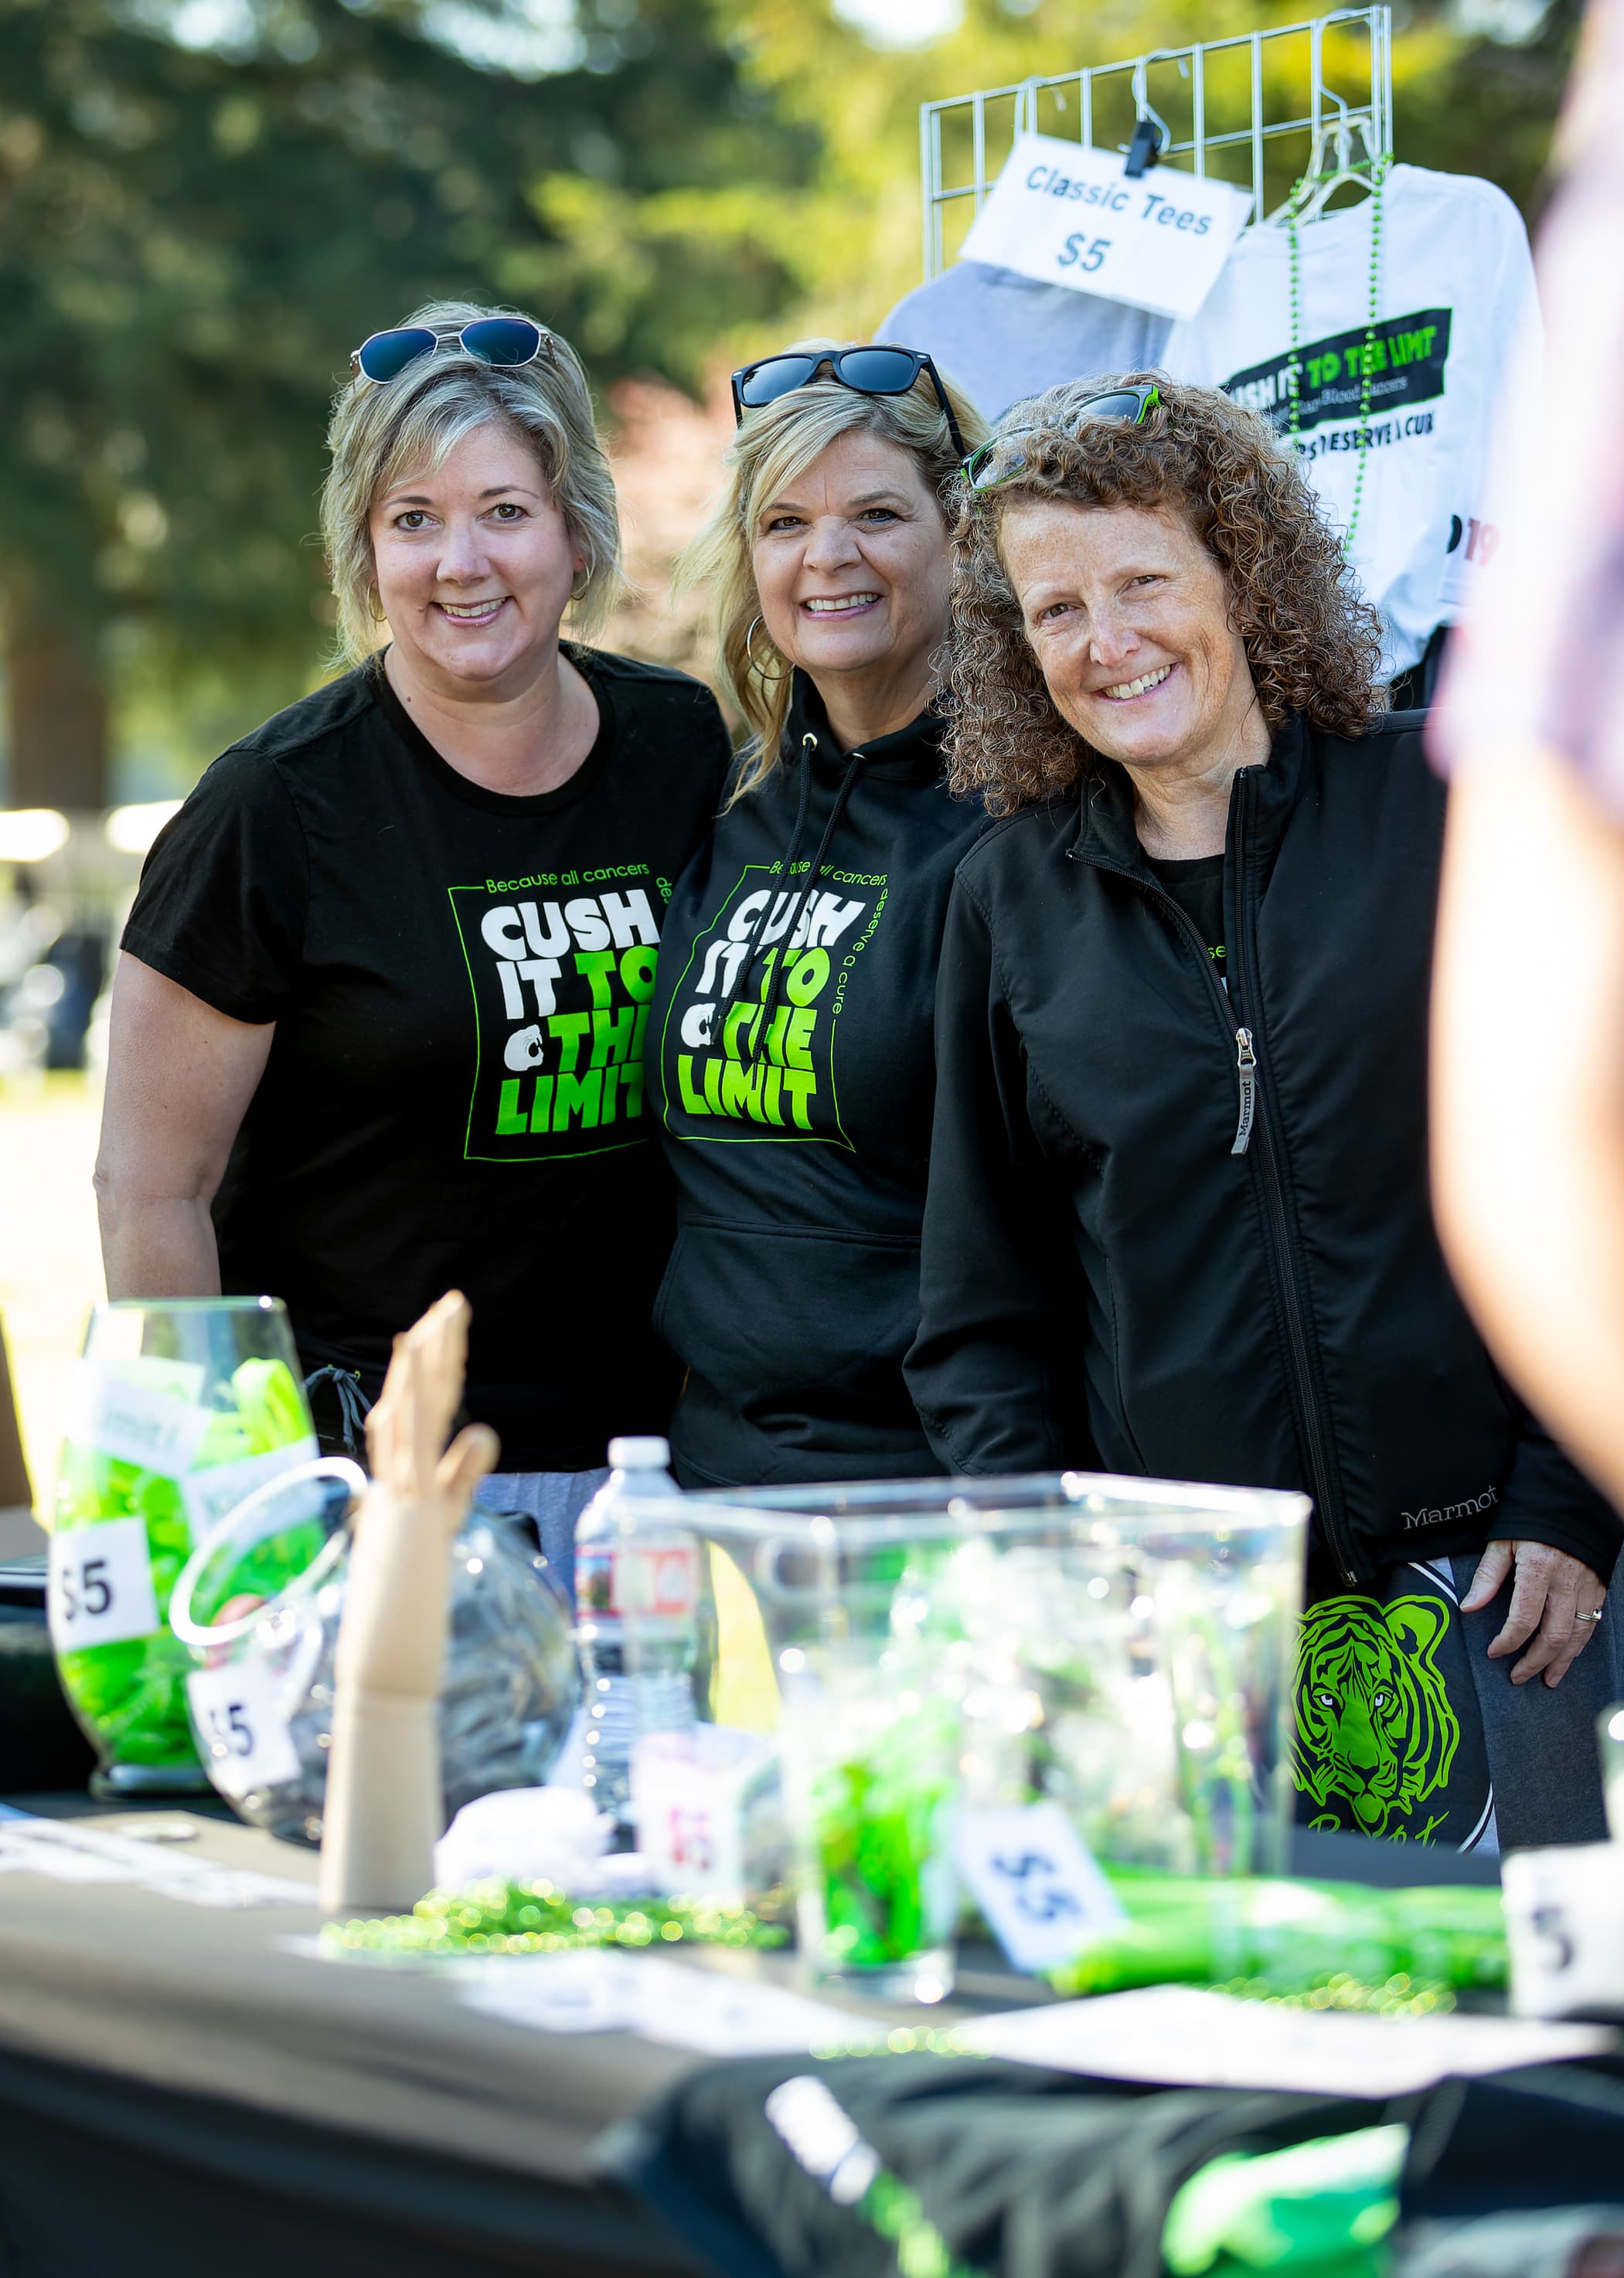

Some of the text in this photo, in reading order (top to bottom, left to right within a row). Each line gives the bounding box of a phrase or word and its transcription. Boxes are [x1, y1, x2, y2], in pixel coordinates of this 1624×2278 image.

[1026, 165, 1213, 236] Classic Tees
[1057, 232, 1112, 272] $5
[1306, 352, 1341, 389] TO
[485, 863, 650, 894] Because all cancers
[832, 870, 888, 887] cancers
[481, 889, 662, 961] CUSH
[832, 887, 889, 1015] deserve a cure
[495, 945, 659, 1020] IT TO
[695, 939, 831, 1007] IT TO
[723, 1001, 818, 1071] THE
[677, 1054, 817, 1131] LIMIT
[1238, 1080, 1252, 1138] Marmot
[1401, 1484, 1500, 1531] Marmot
